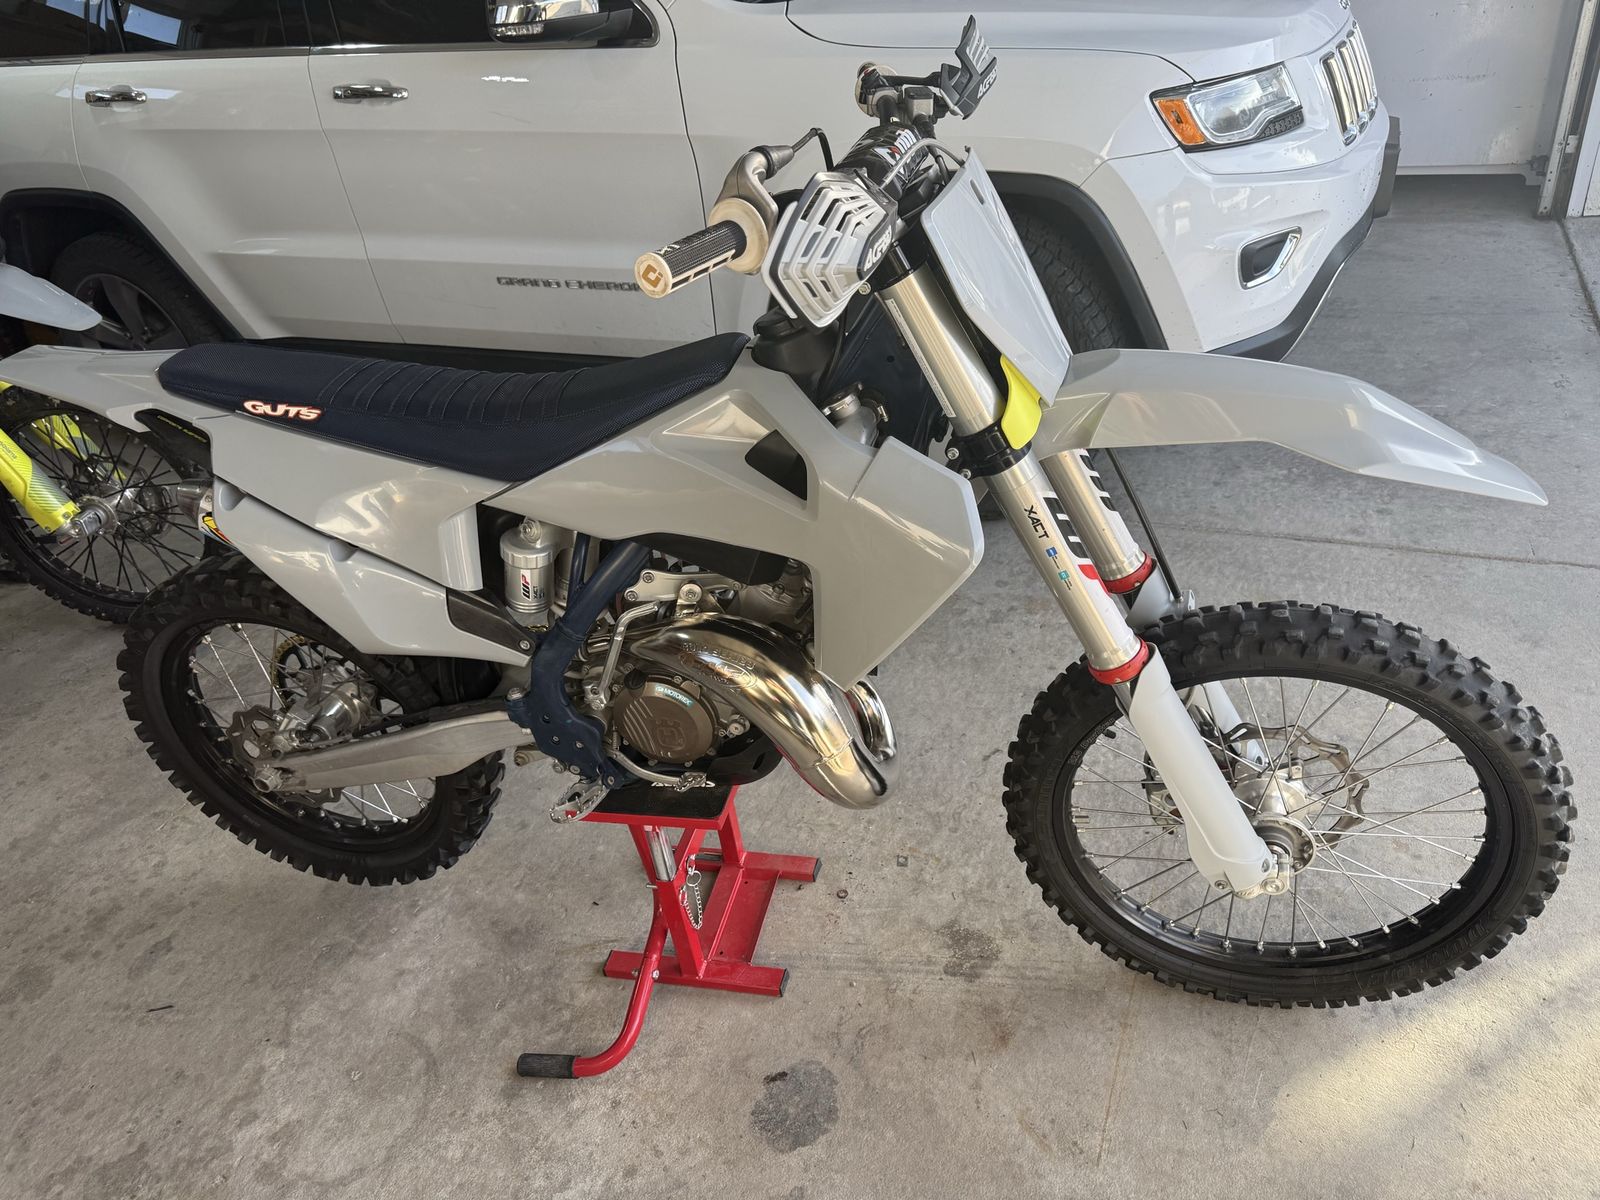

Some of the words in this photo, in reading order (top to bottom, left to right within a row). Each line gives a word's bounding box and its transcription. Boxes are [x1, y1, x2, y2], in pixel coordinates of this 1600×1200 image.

[497, 276, 561, 288] GRAND
[565, 279, 641, 292] CHEROK
[242, 400, 322, 421] GUTS
[1023, 505, 1050, 539] XACT
